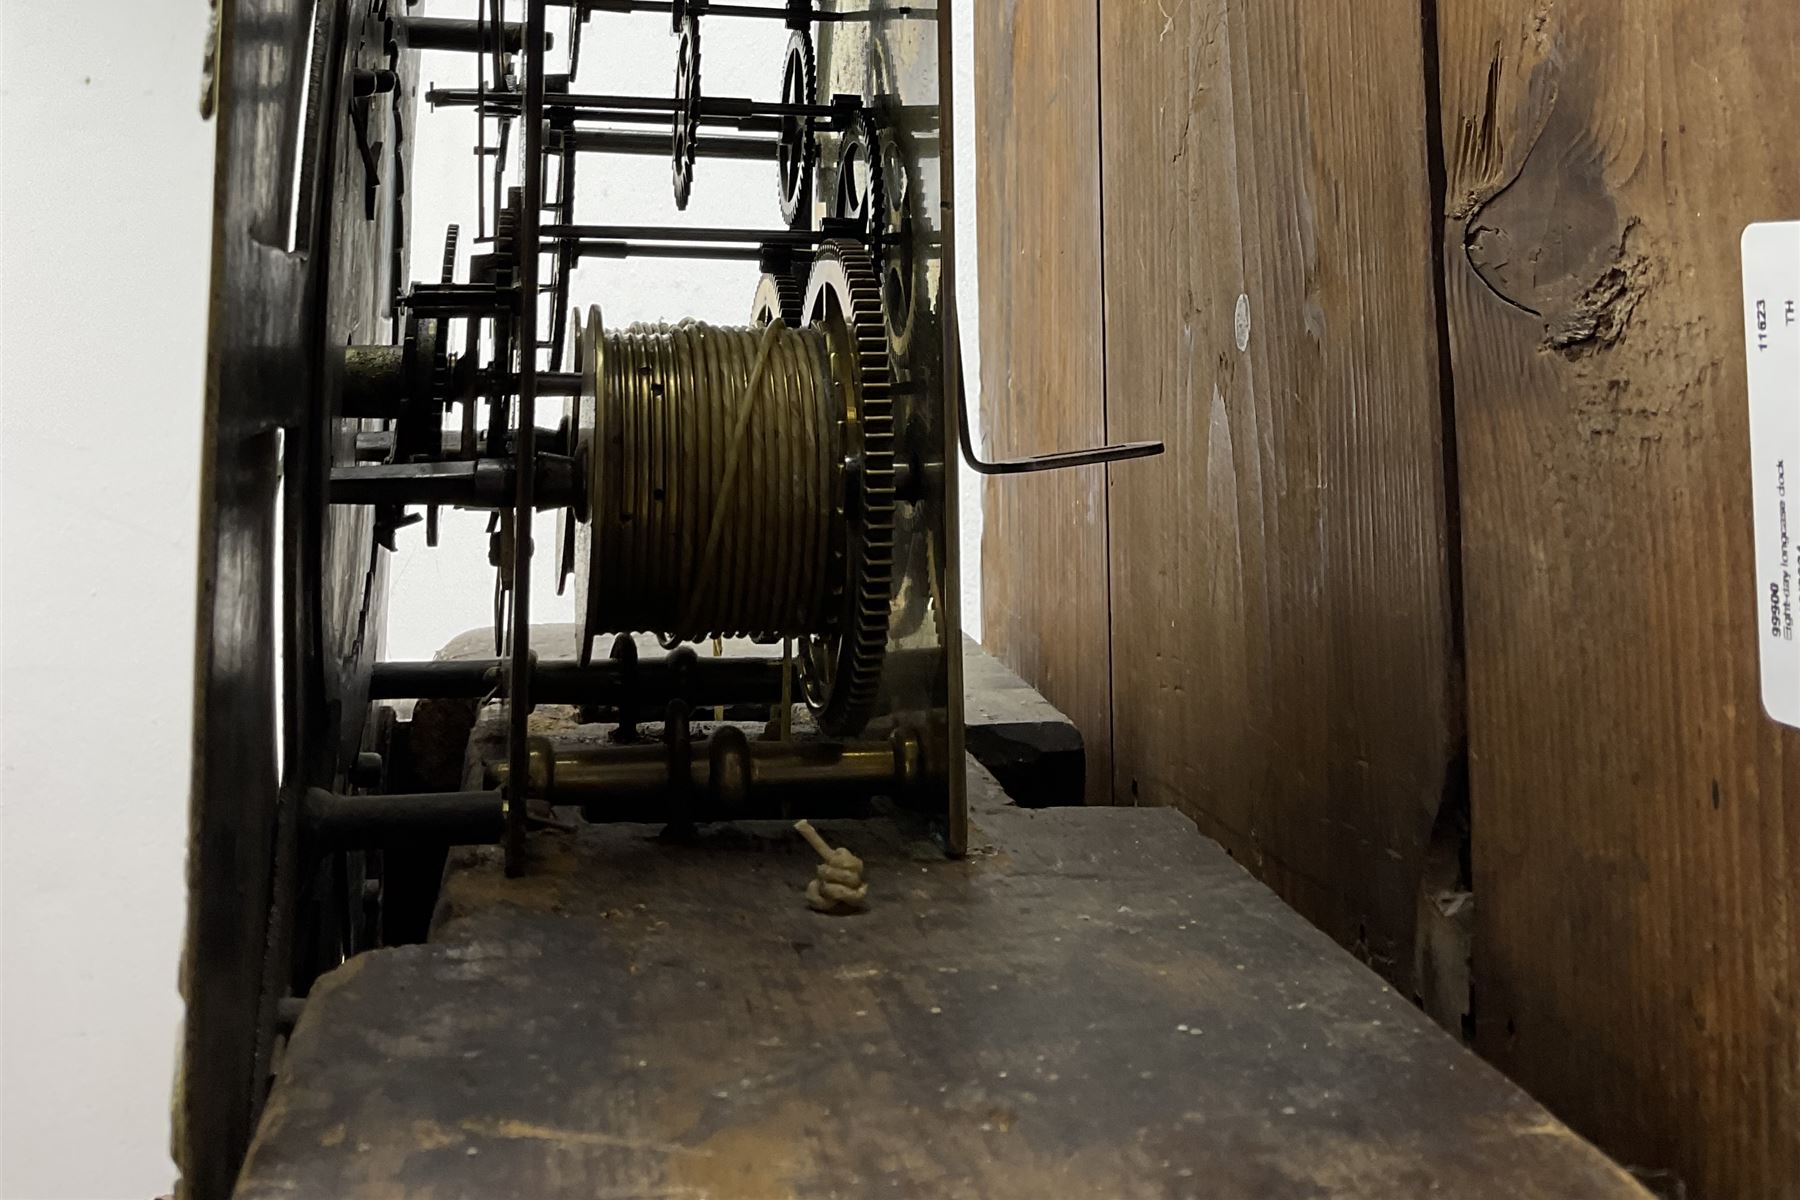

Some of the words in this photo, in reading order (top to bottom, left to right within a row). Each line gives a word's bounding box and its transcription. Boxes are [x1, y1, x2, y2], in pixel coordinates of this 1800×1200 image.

[1756, 299, 1768, 352] 11623
[1784, 299, 1795, 327] TH
[1776, 459, 1786, 497] clock
[1780, 500, 1789, 567] longcase
[1770, 582, 1781, 637] 99900
[1783, 570, 1793, 641] Eight-day
